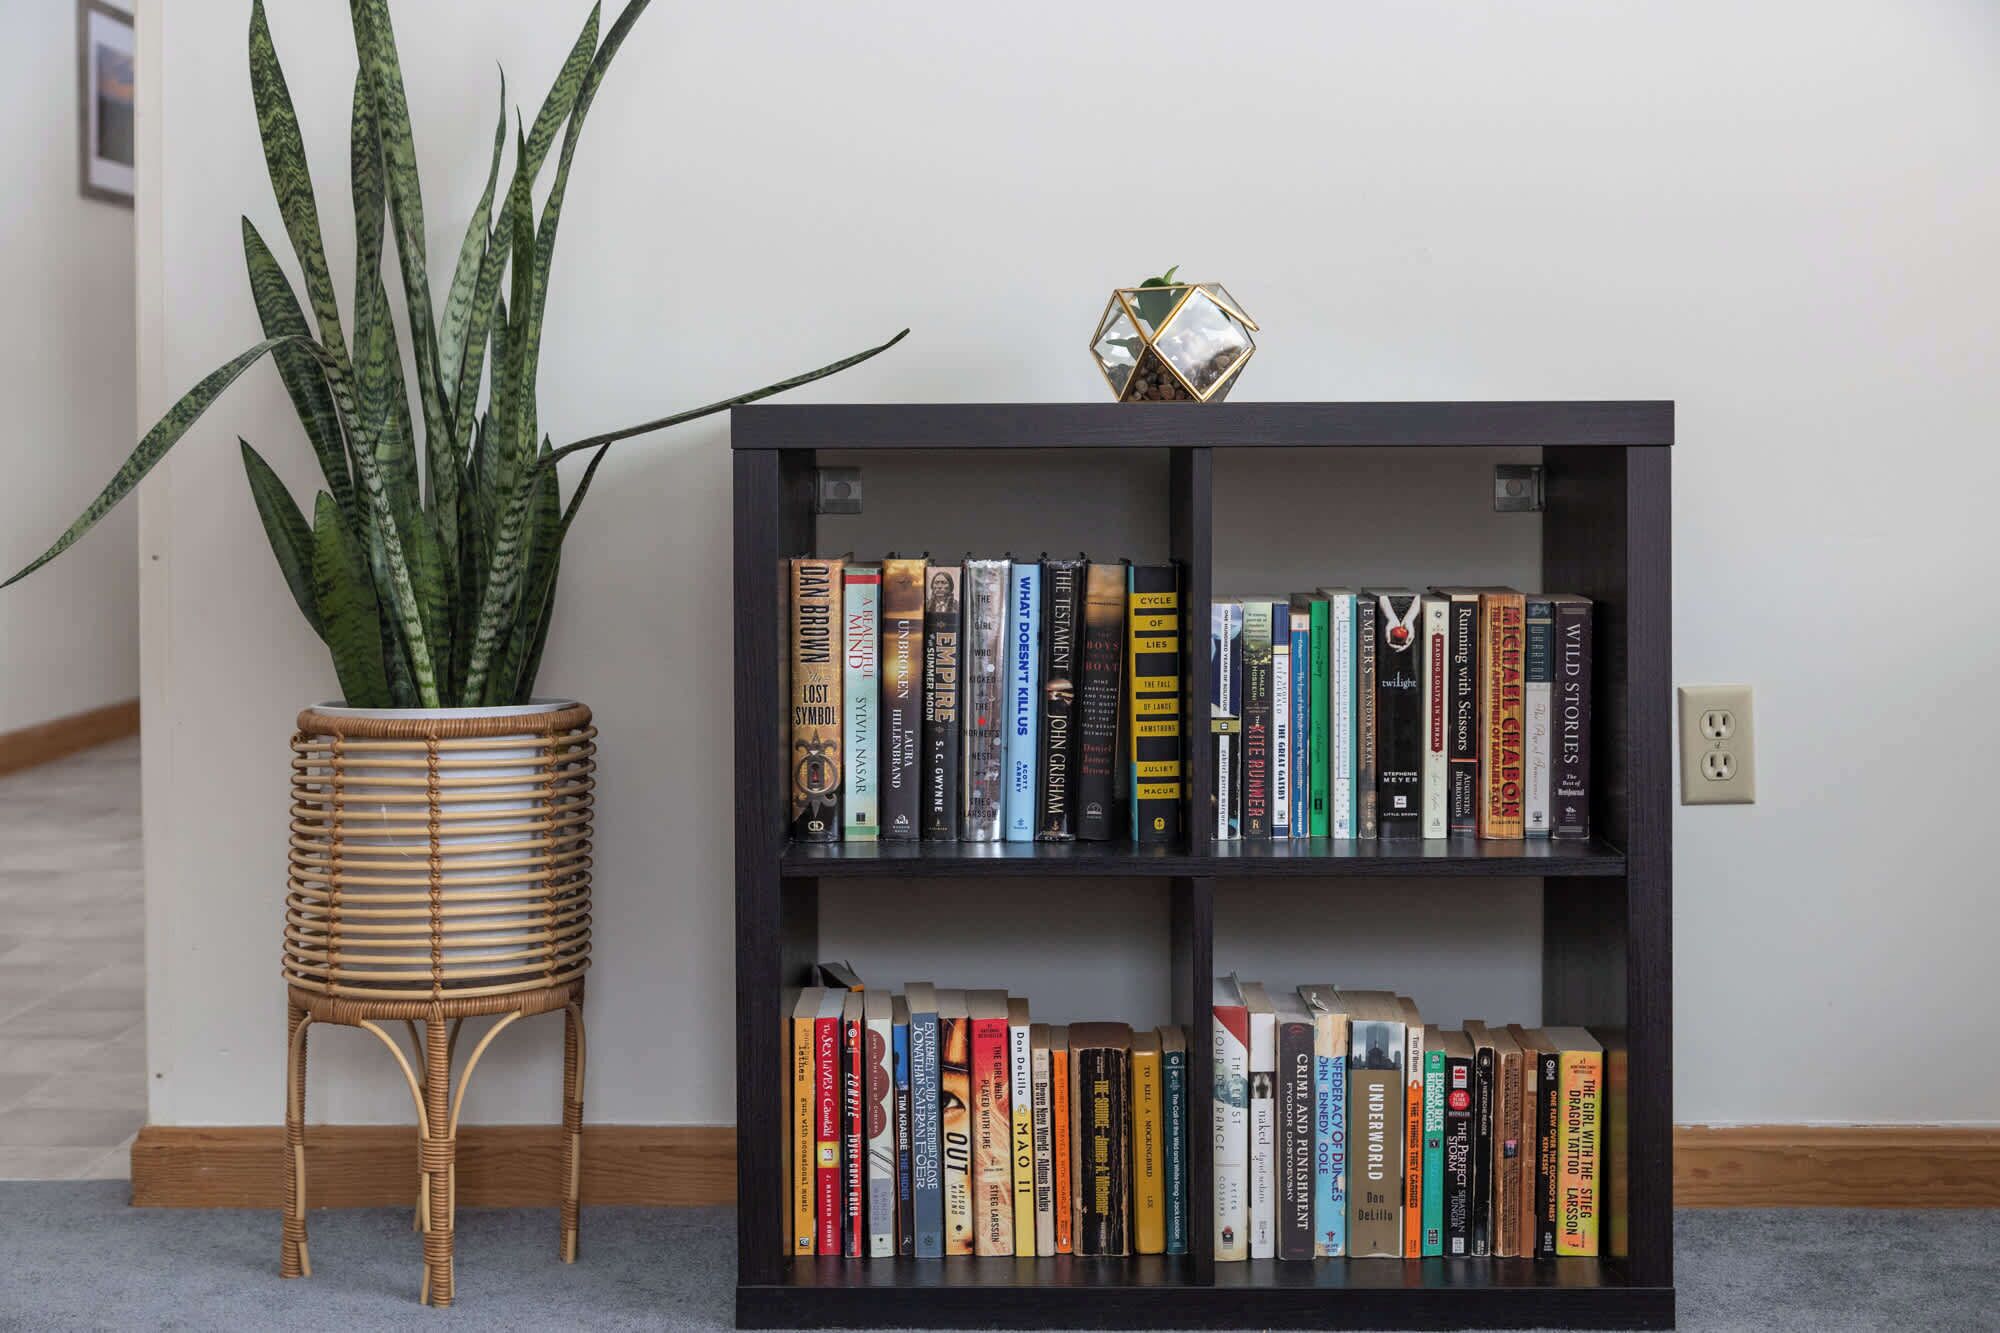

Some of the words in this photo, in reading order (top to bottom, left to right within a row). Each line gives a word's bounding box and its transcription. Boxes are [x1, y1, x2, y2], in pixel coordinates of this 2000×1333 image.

[800, 567, 829, 597] DAN
[1056, 569, 1072, 592] THE
[1020, 577, 1031, 619] WHAT
[800, 605, 829, 663] BROWN
[849, 614, 863, 669] MIND
[862, 610, 873, 680] BEAUTIFUL
[1053, 597, 1071, 671] TESTAMENT
[1363, 609, 1373, 674] EMBERS
[1455, 608, 1471, 664] Running
[1566, 624, 1580, 675] WILD
[897, 620, 909, 699] UNBROKEN
[926, 648, 934, 689] SUMMER
[1019, 622, 1029, 683] DOESN'T
[1502, 607, 1520, 711] MICHAEL
[804, 685, 828, 703] LOST
[935, 632, 956, 723] EMPIRE
[1382, 672, 1416, 689] twilight
[1459, 668, 1471, 695] with
[796, 707, 836, 724] SYMBOL
[926, 692, 934, 720] MOON
[1018, 688, 1029, 714] KILL
[856, 697, 866, 742] SYLVIA
[1018, 717, 1027, 736] US
[1049, 715, 1067, 749] JOHN
[1458, 701, 1470, 750] Scissors
[1564, 682, 1580, 764] STORIES
[892, 709, 902, 788] HILLENBRAND
[904, 730, 913, 766] LAURA
[936, 741, 943, 750] S.
[1248, 725, 1264, 756] KITE
[856, 749, 866, 794] NASAR
[936, 754, 943, 763] C.
[1502, 718, 1520, 817] CHABON
[935, 768, 943, 812] GWYNNE
[1048, 754, 1066, 813] GRISHAM
[1248, 760, 1264, 816] RUNNER
[1455, 771, 1463, 817] BURROUGHS
[798, 1046, 808, 1081] lethem
[914, 1024, 925, 1084] JONATHAN
[925, 1022, 935, 1074] EXTREMELY
[993, 1046, 1002, 1060] THE
[926, 1076, 935, 1100] LOUD
[994, 1063, 1002, 1080] GIRL
[1017, 1058, 1026, 1095] DeLillo
[1095, 1080, 1108, 1094] THE
[1144, 1067, 1150, 1077] TO
[1297, 1054, 1308, 1099] CRIME
[1435, 1072, 1443, 1101] EDGAR
[848, 1073, 859, 1118] ZOMBIE
[981, 1079, 989, 1107] PLAYED
[994, 1083, 1002, 1099] WHO
[1035, 1082, 1046, 1105] Brave
[1426, 1073, 1435, 1132] BURROUGHS
[1583, 1080, 1595, 1098] THE
[915, 1087, 926, 1139] SAFRAN
[982, 1110, 990, 1129] WITH
[1036, 1108, 1047, 1124] New
[1095, 1098, 1108, 1128] SOURCE
[1297, 1105, 1308, 1134] AND
[1410, 1102, 1418, 1117] THE
[1435, 1108, 1443, 1131] RICE
[1568, 1090, 1579, 1133] DRAGON
[1583, 1102, 1595, 1126] GIRL
[927, 1112, 937, 1159] INCREDIBLY
[982, 1132, 990, 1149] FIRE
[1037, 1127, 1048, 1151] World
[1258, 1110, 1270, 1144] naked
[1368, 1084, 1384, 1180] UNDERWORLD
[1410, 1121, 1418, 1149] THINGS
[1582, 1130, 1594, 1156] WITH
[947, 1132, 968, 1175] OUT
[1017, 1123, 1030, 1167] MAO
[1095, 1136, 1108, 1162] James
[1410, 1152, 1418, 1170] THEY
[1449, 1136, 1457, 1171] STORM
[1567, 1137, 1579, 1174] TATTOO
[916, 1141, 925, 1188] FOER
[927, 1161, 937, 1189] CLOSE
[1038, 1159, 1048, 1184] Aldous
[1096, 1166, 1108, 1174] A.
[1457, 1145, 1468, 1187] PERFECT
[1582, 1160, 1593, 1180] THE
[1038, 1187, 1050, 1212] Huxley
[1096, 1176, 1109, 1215] Michener
[1297, 1139, 1308, 1229] PUNISHMENT
[1367, 1192, 1384, 1203] Don
[1409, 1174, 1418, 1208] CARRIED
[1359, 1208, 1392, 1220] DeLillo
[1451, 1196, 1459, 1228] JUNGER
[1566, 1188, 1578, 1235] LARSSON
[1581, 1188, 1592, 1218] STIEG
[991, 1209, 999, 1242] LARSSON
